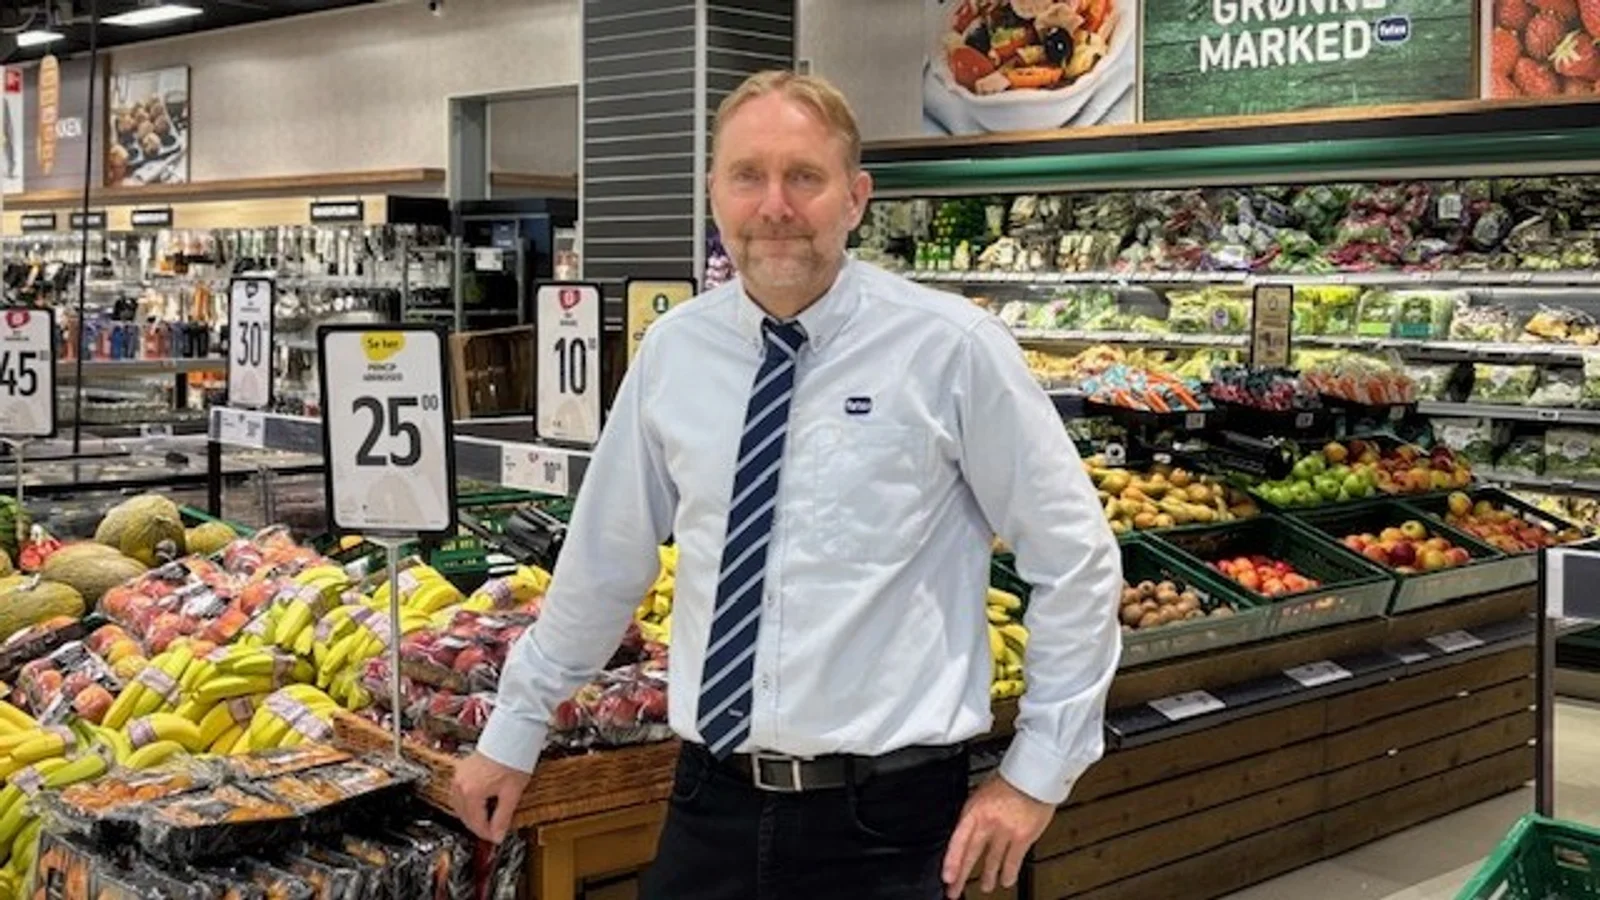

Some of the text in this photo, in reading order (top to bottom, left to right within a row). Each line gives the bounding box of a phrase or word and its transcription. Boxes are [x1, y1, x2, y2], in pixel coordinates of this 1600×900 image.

[1212, 0, 1387, 25] GRØ
[1199, 19, 1372, 73] MARKED
[237, 321, 262, 367] 30
[367, 337, 399, 348] Se her
[0, 350, 38, 396] 45
[554, 337, 587, 396] 10
[351, 394, 439, 467] 25 00
